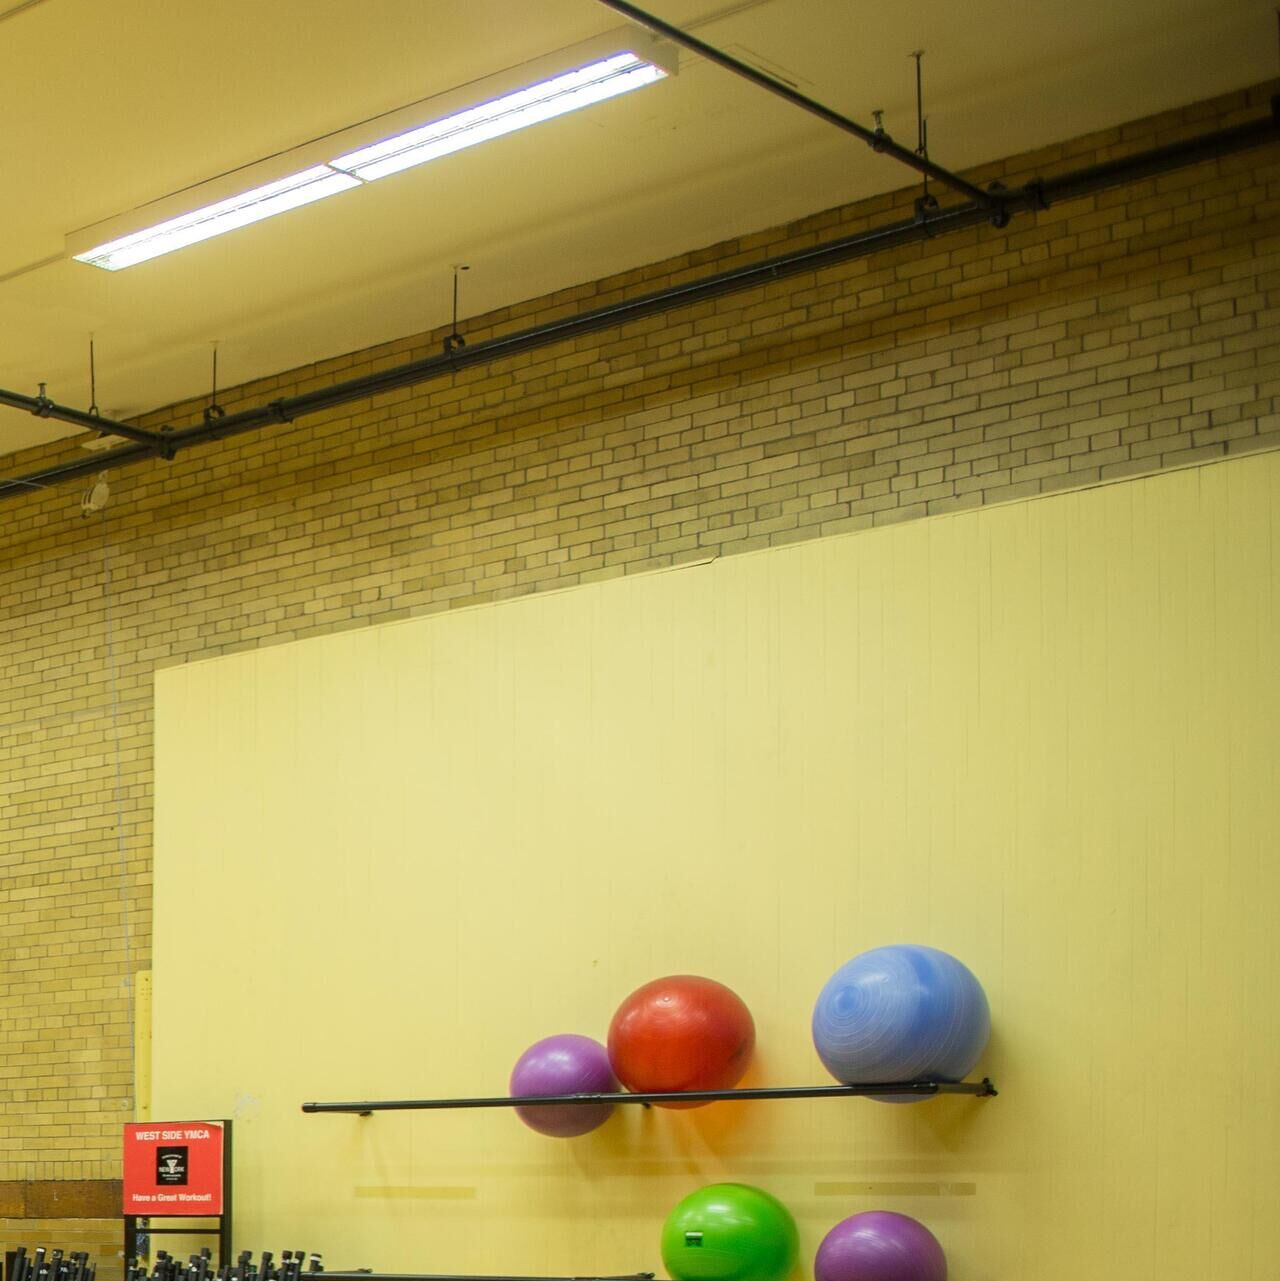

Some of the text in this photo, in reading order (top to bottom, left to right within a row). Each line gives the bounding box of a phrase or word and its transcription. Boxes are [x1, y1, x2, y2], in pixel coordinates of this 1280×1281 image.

[136, 1130, 210, 1140] WEST SIDE YMCA
[132, 1193, 150, 1201] Have
[157, 1193, 177, 1201] Great
[178, 1193, 211, 1201] Workout!
